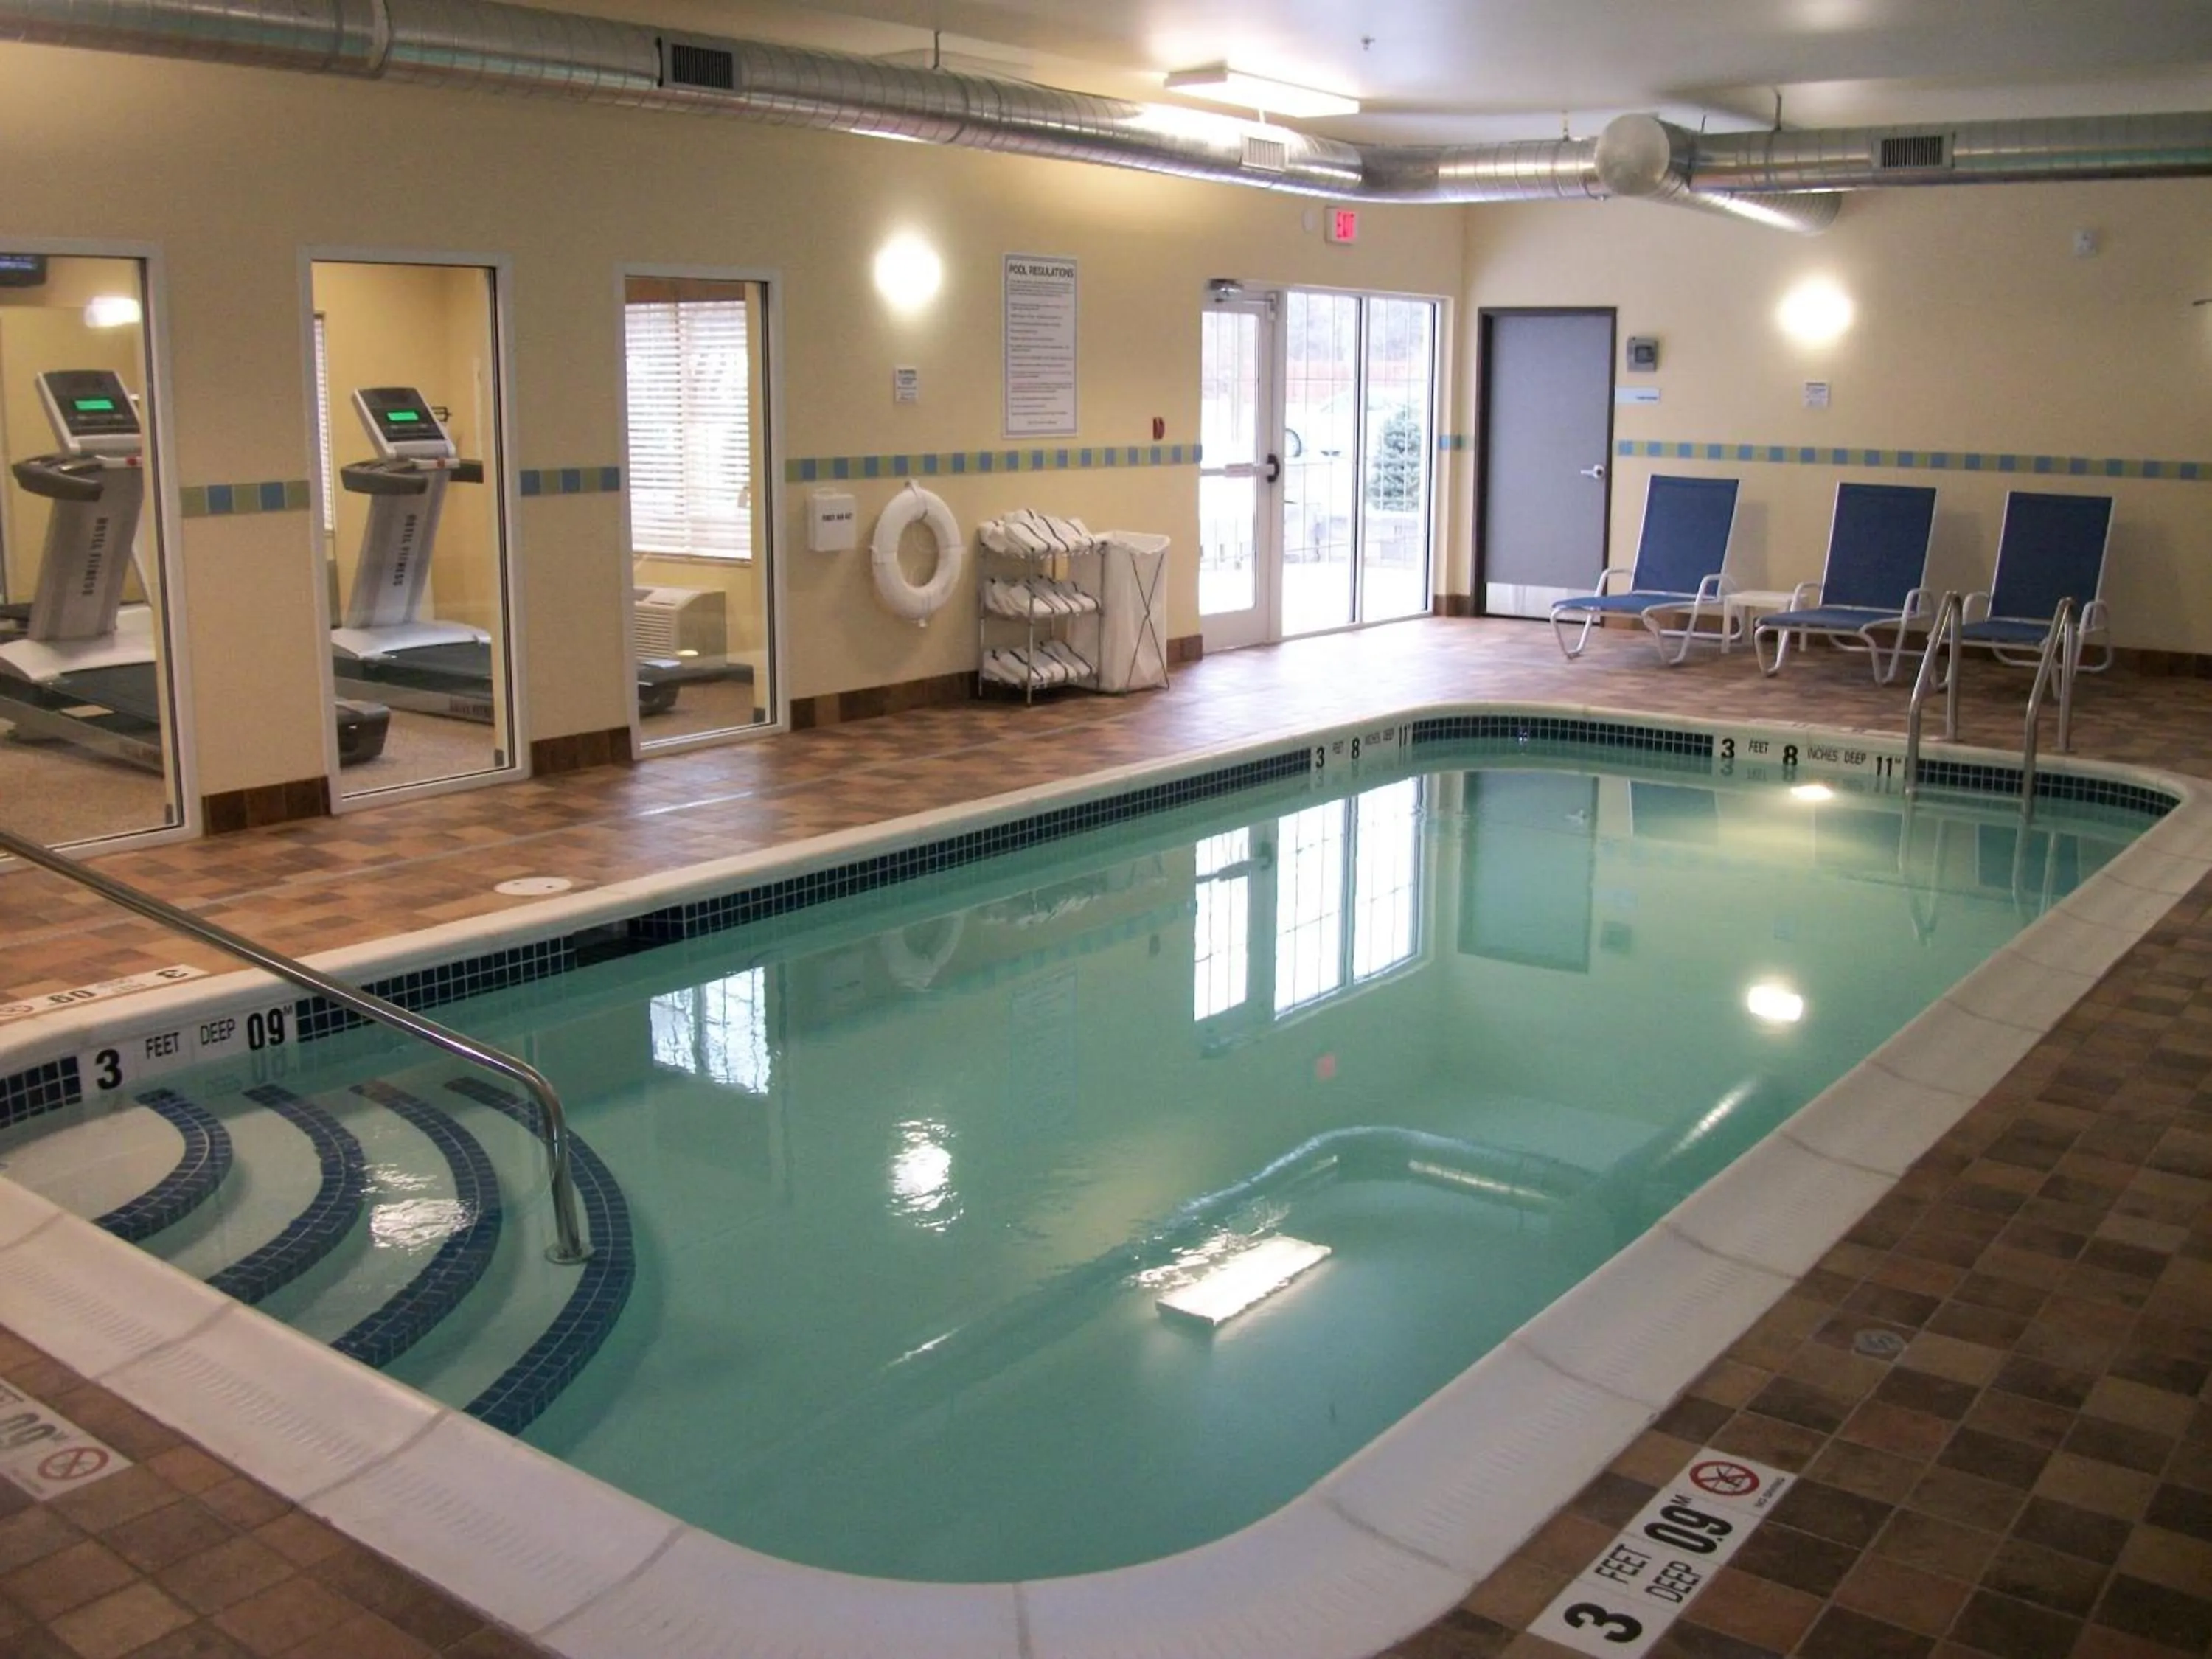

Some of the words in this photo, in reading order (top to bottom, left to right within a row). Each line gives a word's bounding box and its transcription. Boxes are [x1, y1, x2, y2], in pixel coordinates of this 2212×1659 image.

[1009, 263, 1028, 275] POOL
[1029, 265, 1074, 278] REGULATIONS
[1315, 745, 1325, 768] 3
[1352, 737, 1360, 759] 8
[1721, 738, 1735, 759] 3
[1748, 740, 1769, 754] FEET
[1783, 745, 1798, 766] 8
[1807, 747, 1837, 762] INCHES
[1844, 751, 1866, 765] DEEP
[95, 1049, 122, 1091] 3
[146, 1032, 180, 1060] FEET
[200, 1018, 236, 1046] DEEP
[1594, 1543, 1652, 1585] FEET
[1644, 1559, 1702, 1604] DEEP
[1562, 1601, 1643, 1644] 3
